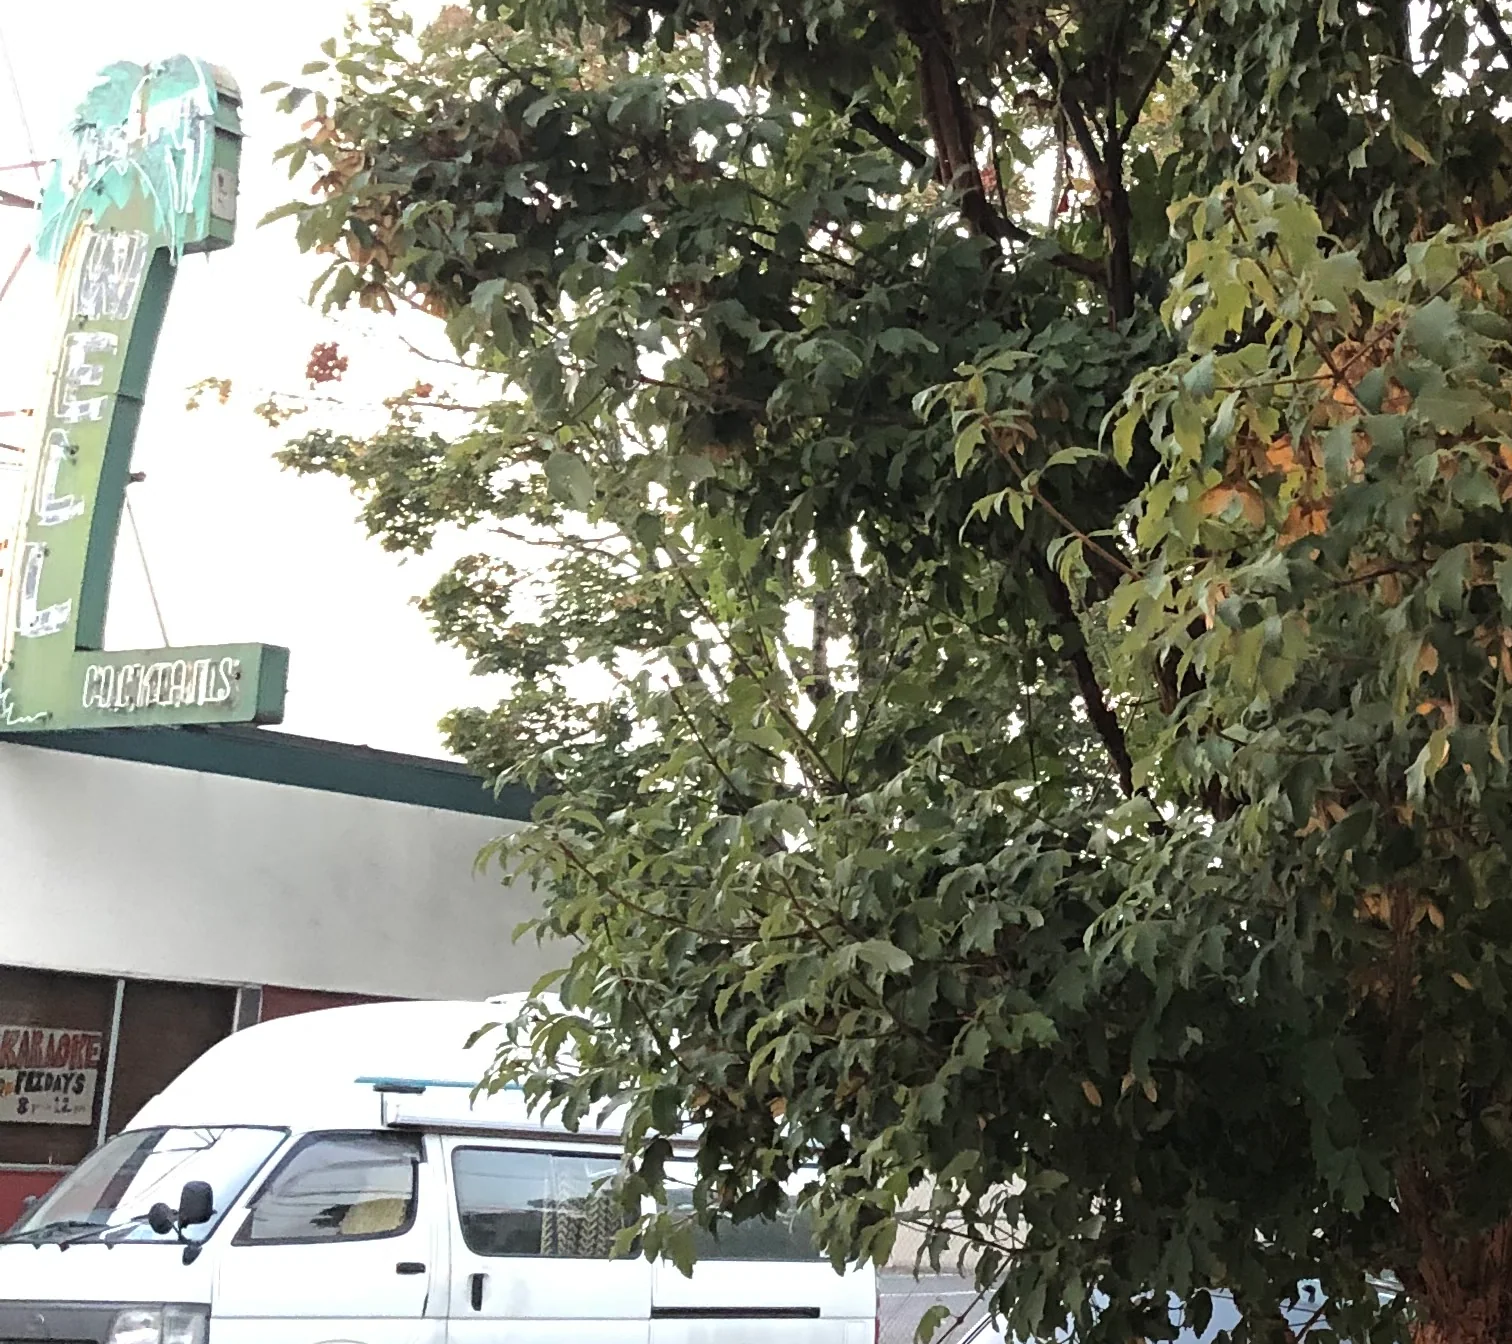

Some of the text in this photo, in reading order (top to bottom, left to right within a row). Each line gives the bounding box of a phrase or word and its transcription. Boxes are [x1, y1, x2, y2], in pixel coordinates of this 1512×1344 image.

[82, 657, 240, 711] COCKTAILS
[0, 1029, 101, 1070] KARAOKE
[15, 1070, 86, 1095] FRIDAYS
